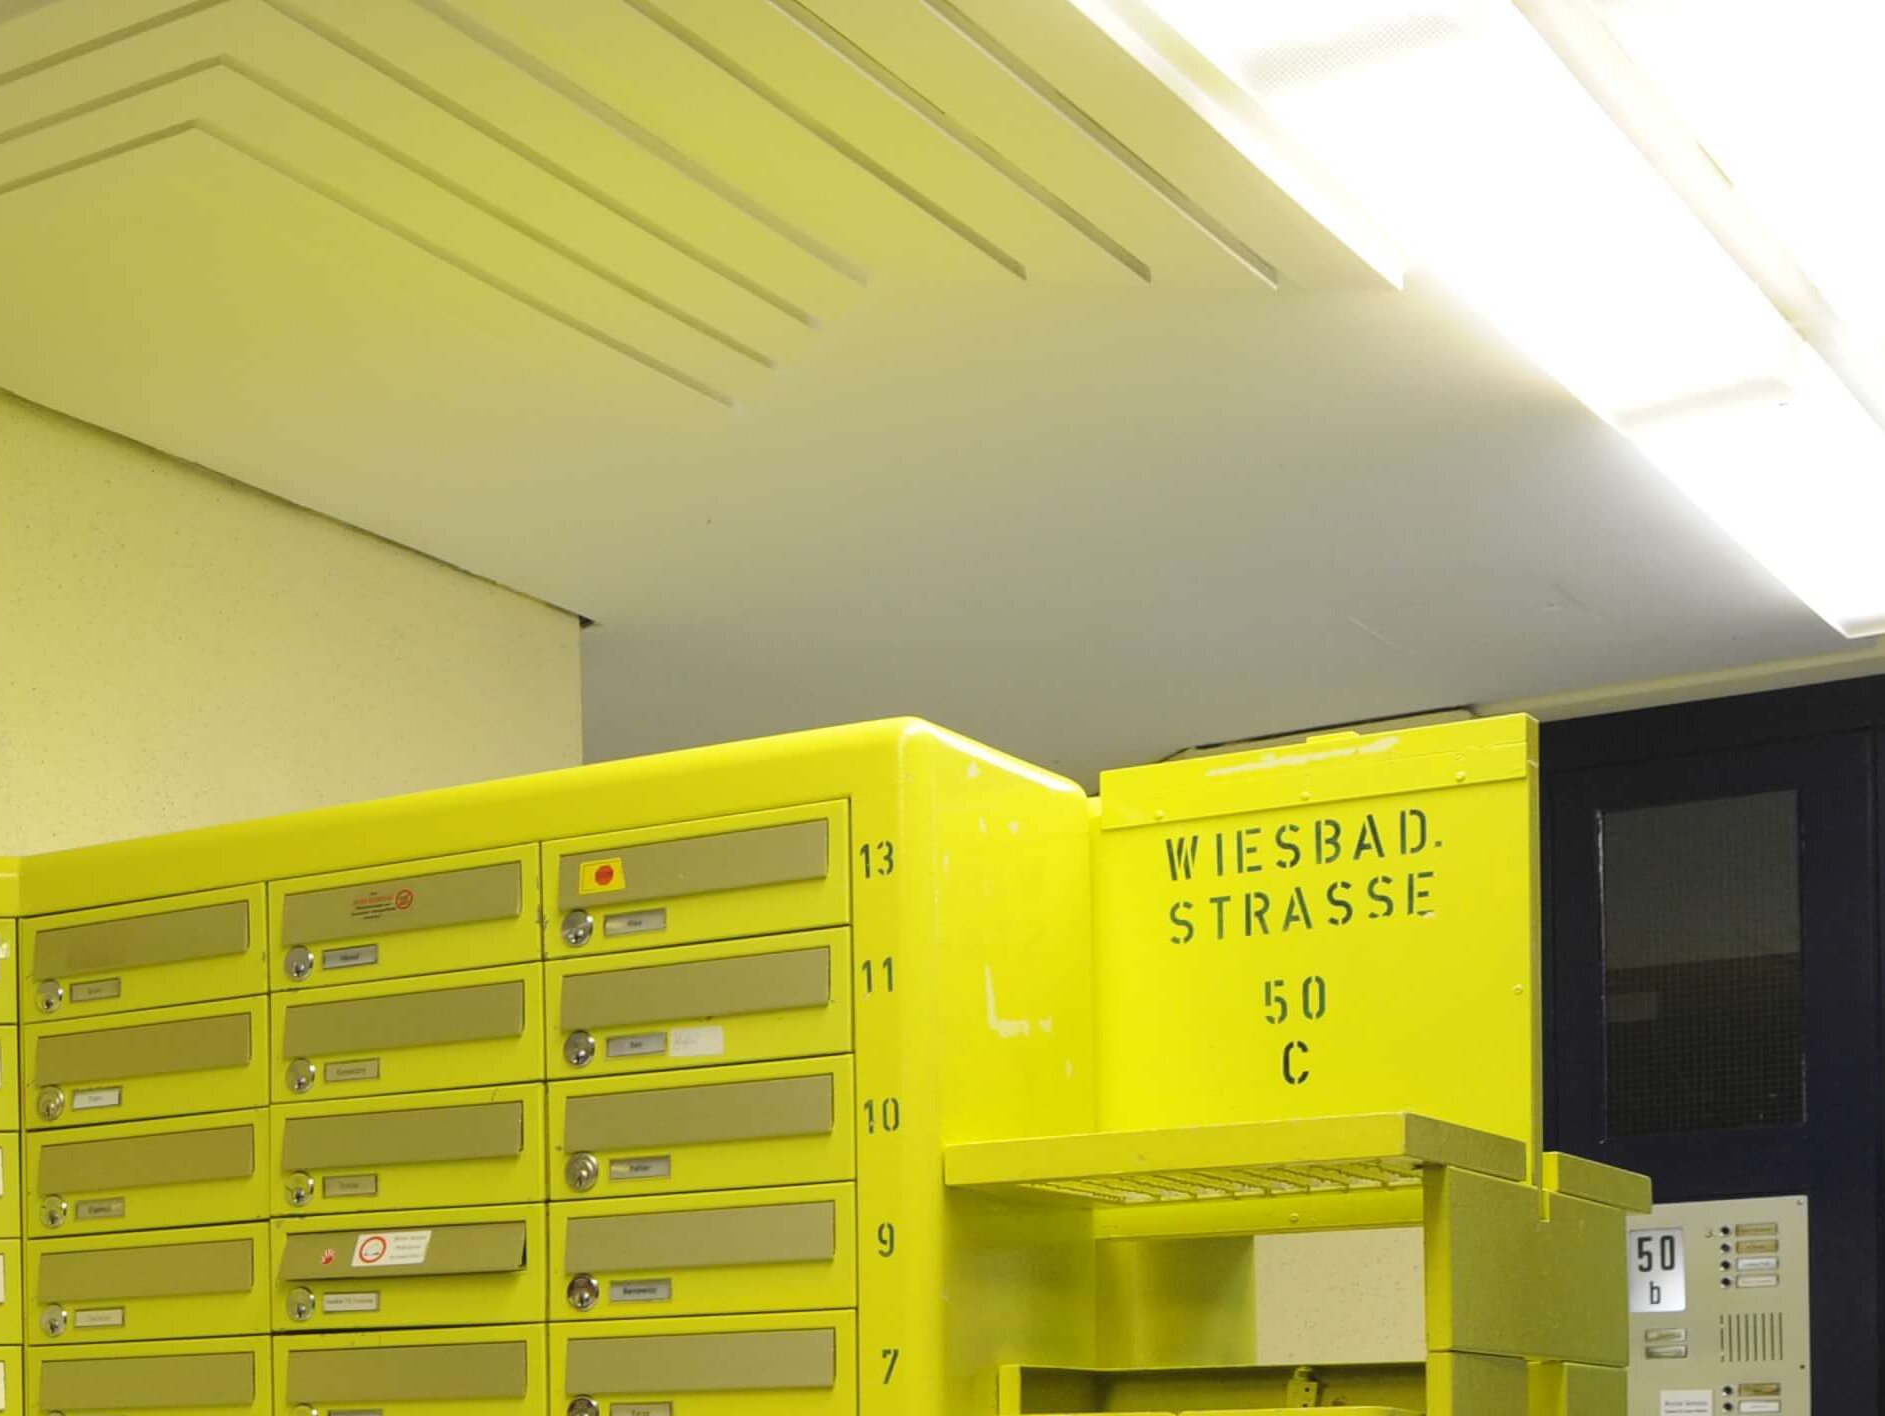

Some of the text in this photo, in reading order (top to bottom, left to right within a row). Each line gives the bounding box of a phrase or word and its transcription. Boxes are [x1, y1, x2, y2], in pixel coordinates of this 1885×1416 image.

[859, 840, 895, 879] 13
[1166, 809, 1442, 881] WIESBAD.
[1169, 871, 1436, 945] STRASSE
[861, 956, 895, 993] 11
[1264, 975, 1327, 1025] 50
[1282, 1041, 1310, 1085] C
[864, 1097, 900, 1135] 10
[877, 1222, 895, 1258] 9
[1637, 1234, 1676, 1273] 50
[1650, 1280, 1661, 1305] b
[882, 1348, 899, 1384] 7
